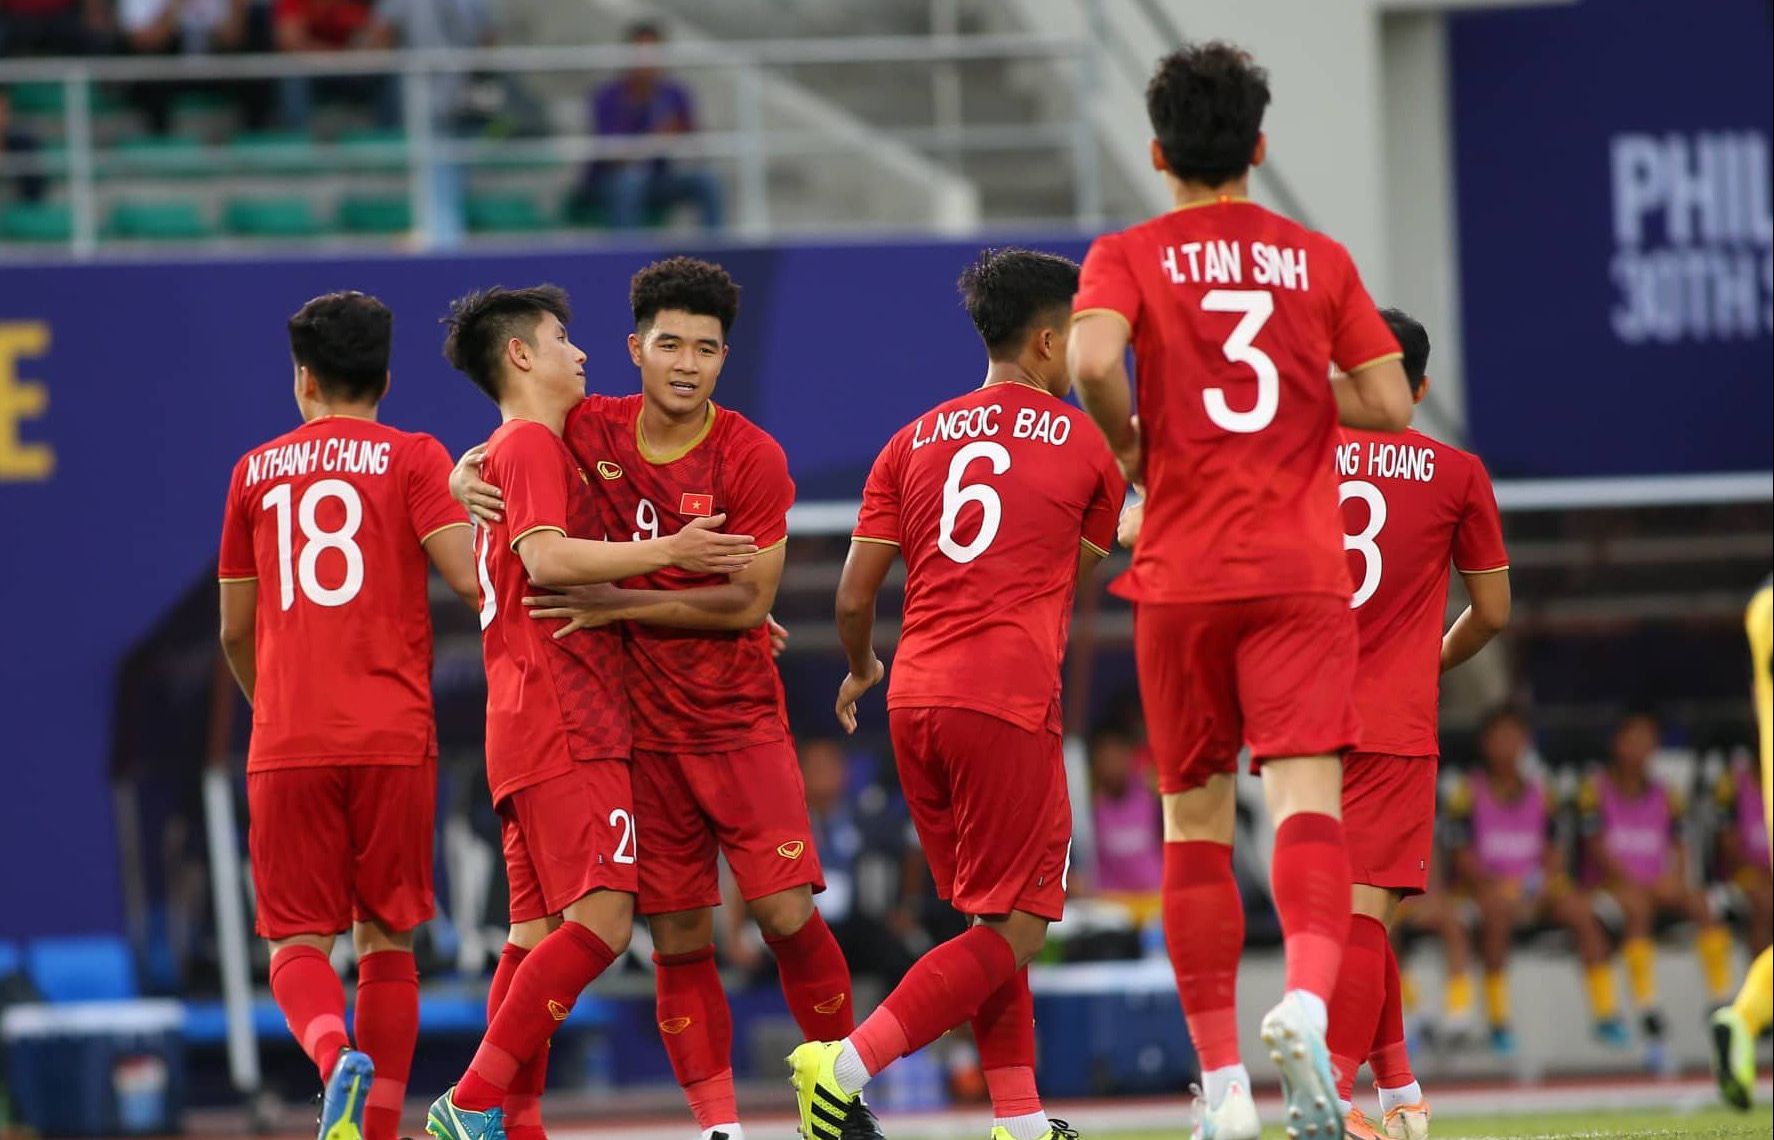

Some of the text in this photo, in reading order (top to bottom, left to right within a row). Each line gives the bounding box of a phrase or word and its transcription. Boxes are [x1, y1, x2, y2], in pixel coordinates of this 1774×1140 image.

[1610, 252, 1757, 342] 30TH
[1200, 289, 1280, 433] 3
[246, 437, 391, 487] N.THANH CHUNG
[912, 404, 1071, 450] L.NGOC BAO
[1367, 442, 1435, 482] HOANG
[632, 498, 659, 541] 9
[937, 440, 1011, 564] 6
[262, 478, 365, 611] 18
